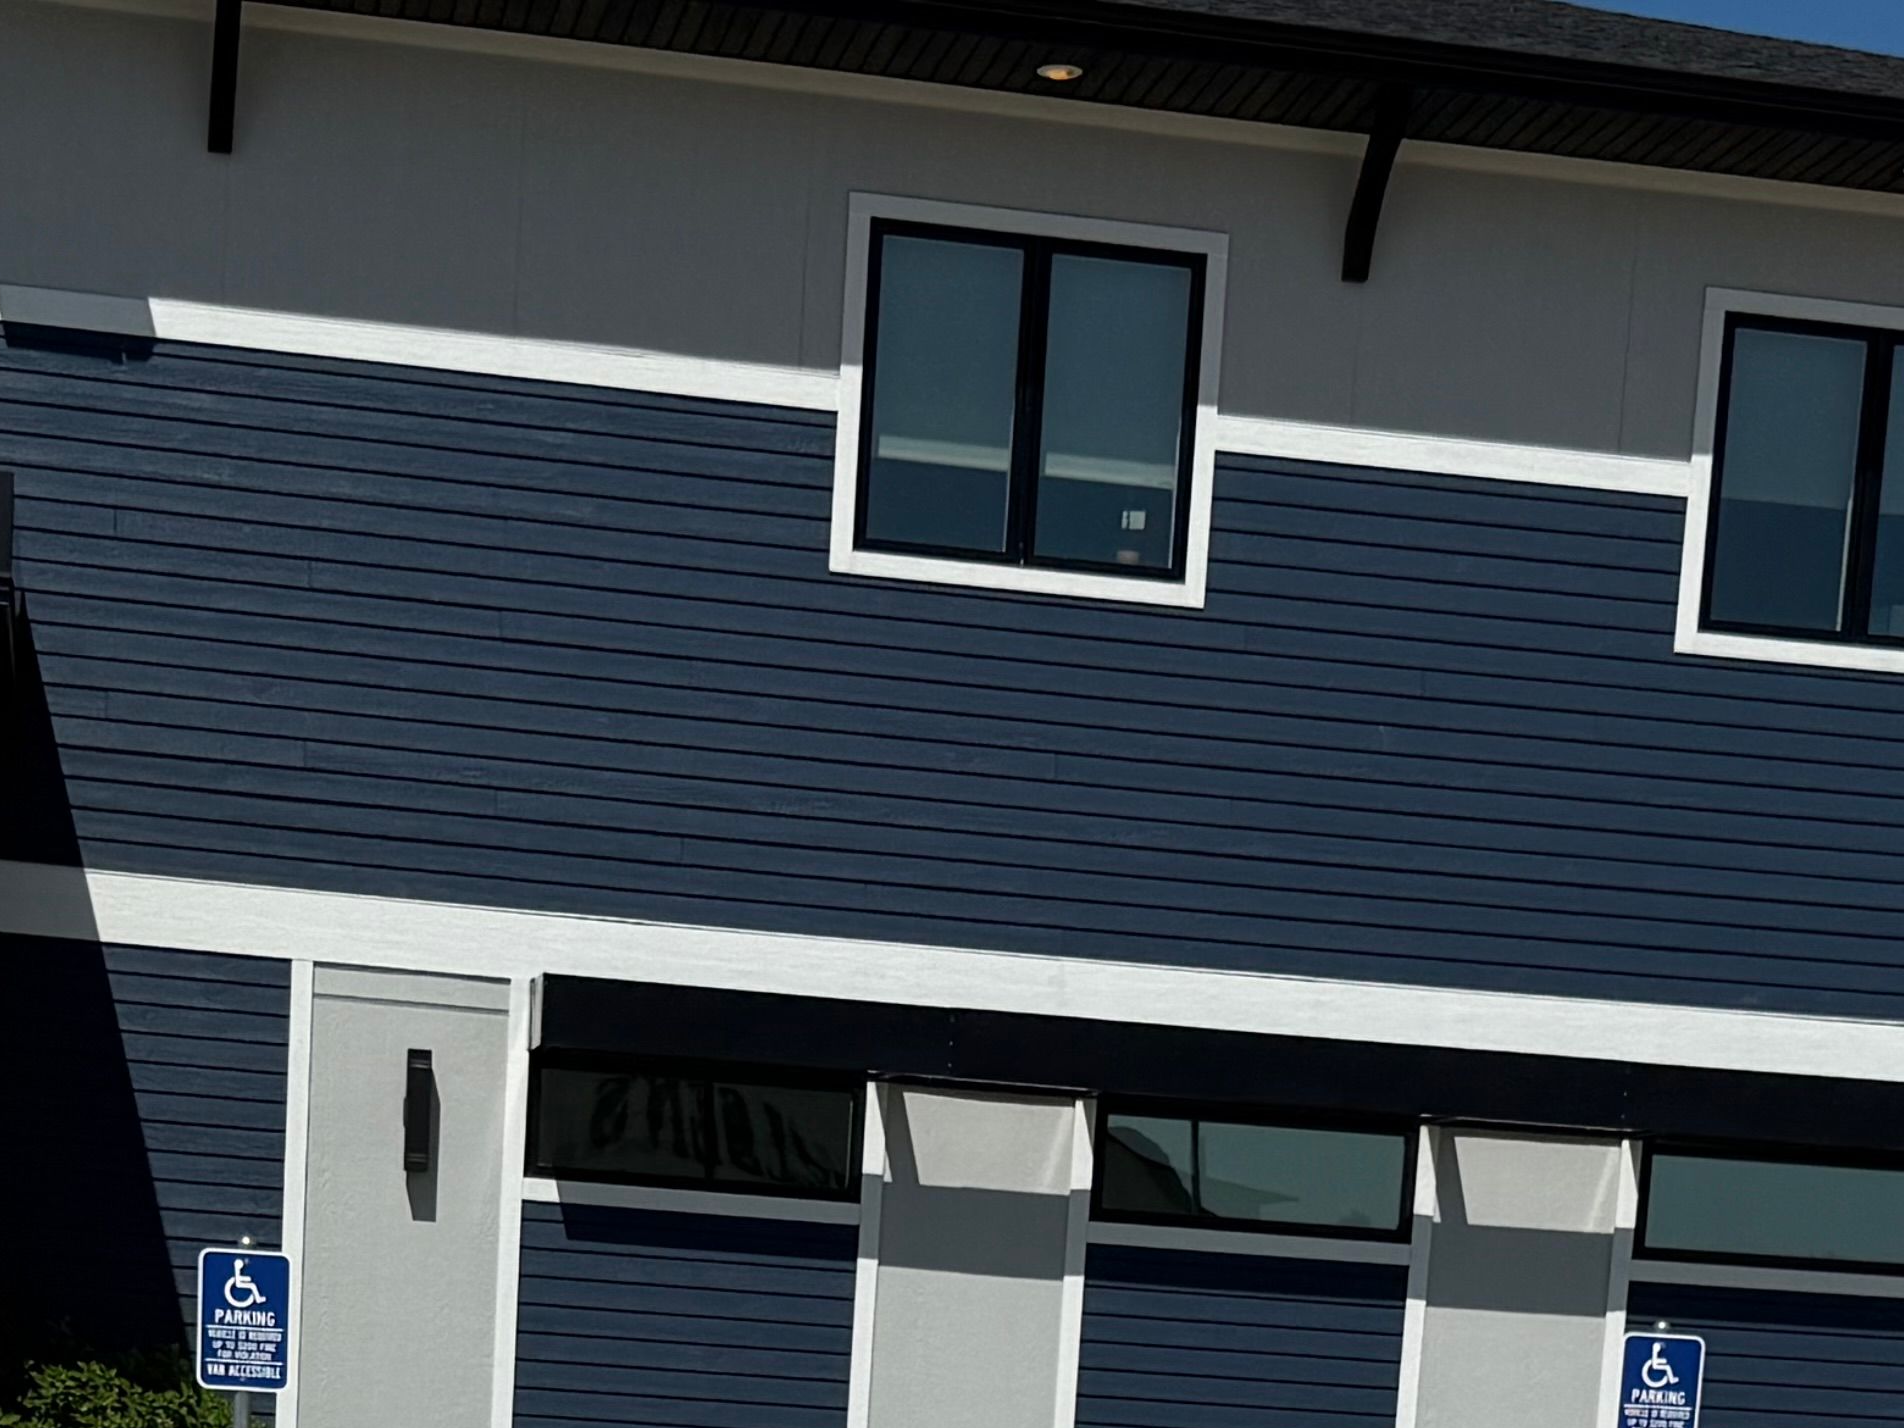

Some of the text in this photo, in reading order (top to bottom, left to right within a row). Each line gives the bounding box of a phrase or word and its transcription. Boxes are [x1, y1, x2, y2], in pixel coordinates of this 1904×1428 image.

[214, 1308, 276, 1327] PARKING
[207, 1363, 281, 1379] VAN ACCESSIBLE
[1631, 1388, 1686, 1406] PARKING
